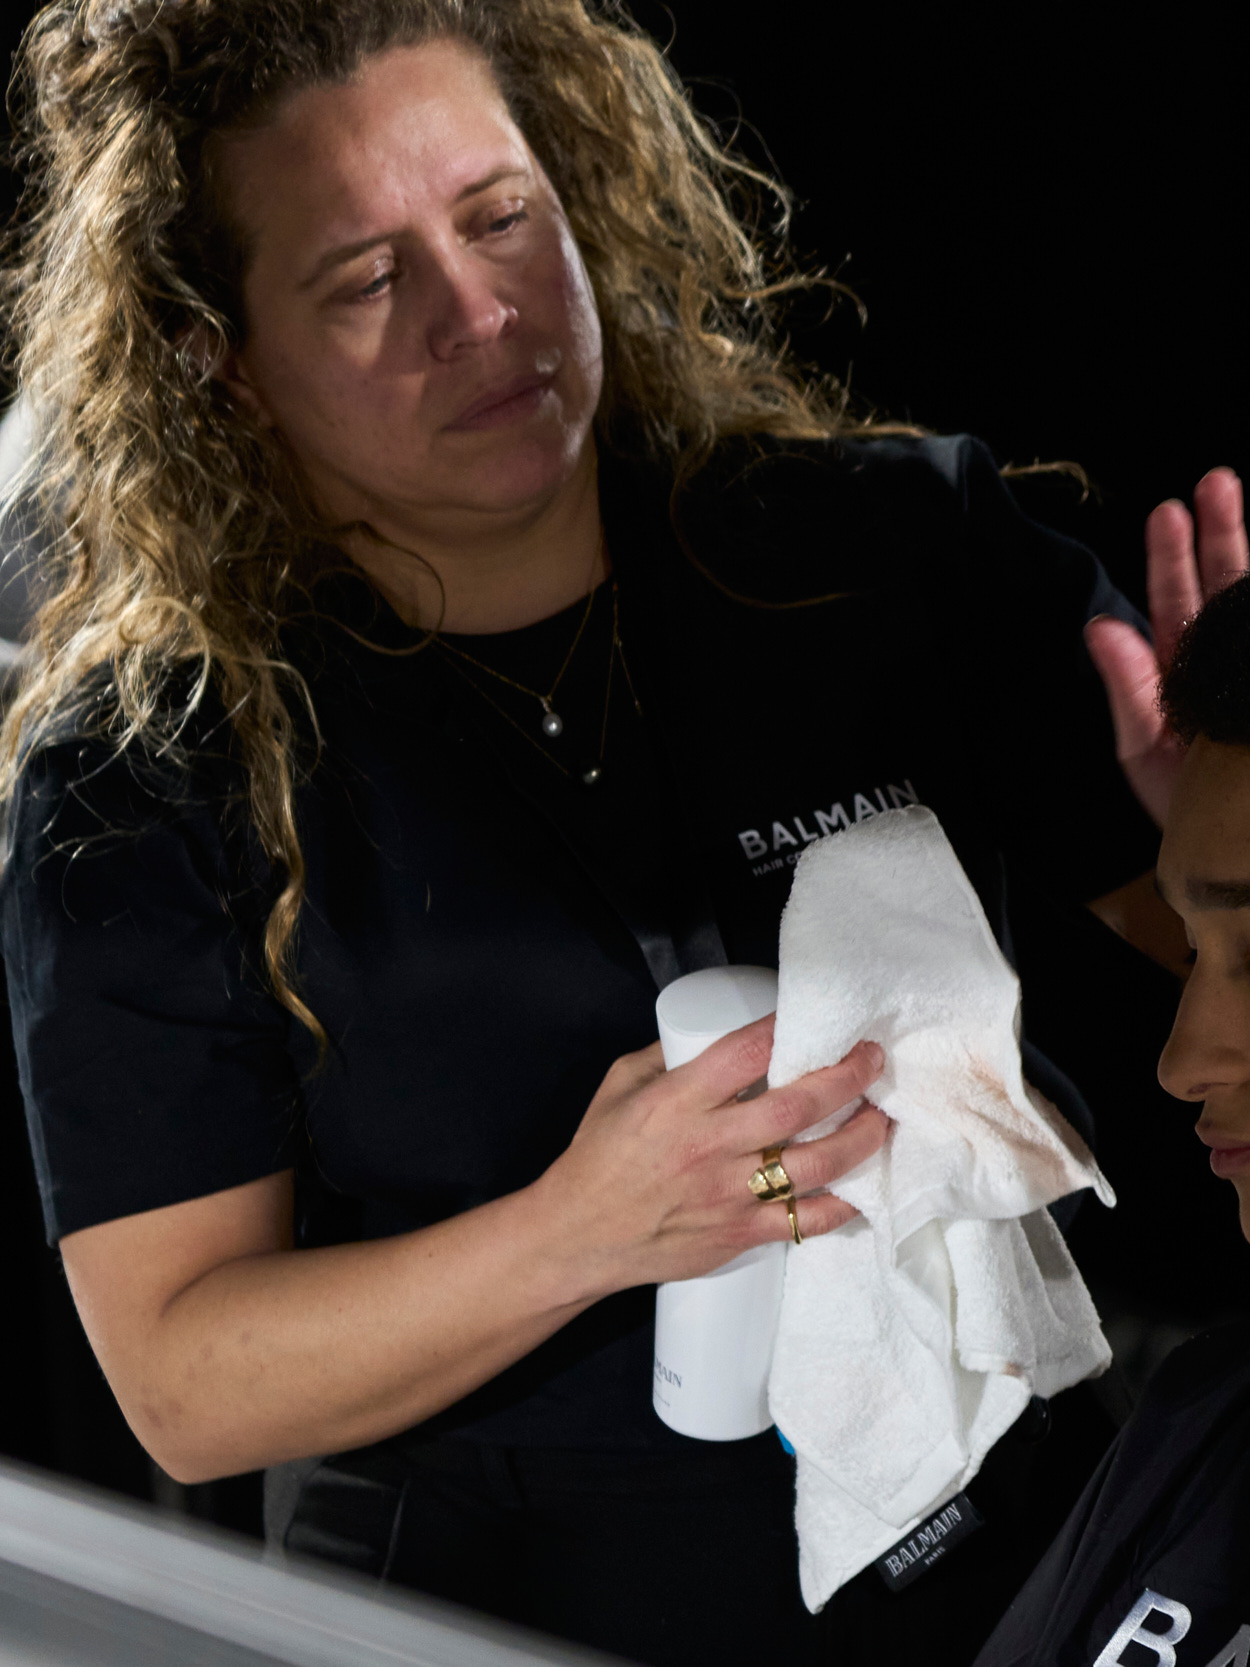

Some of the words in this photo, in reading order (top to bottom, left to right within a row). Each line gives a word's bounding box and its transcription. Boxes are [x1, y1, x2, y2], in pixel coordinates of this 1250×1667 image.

[737, 778, 920, 861] BALMAIN
[752, 857, 784, 877] HAIR
[884, 1502, 963, 1578] BALMAIN
